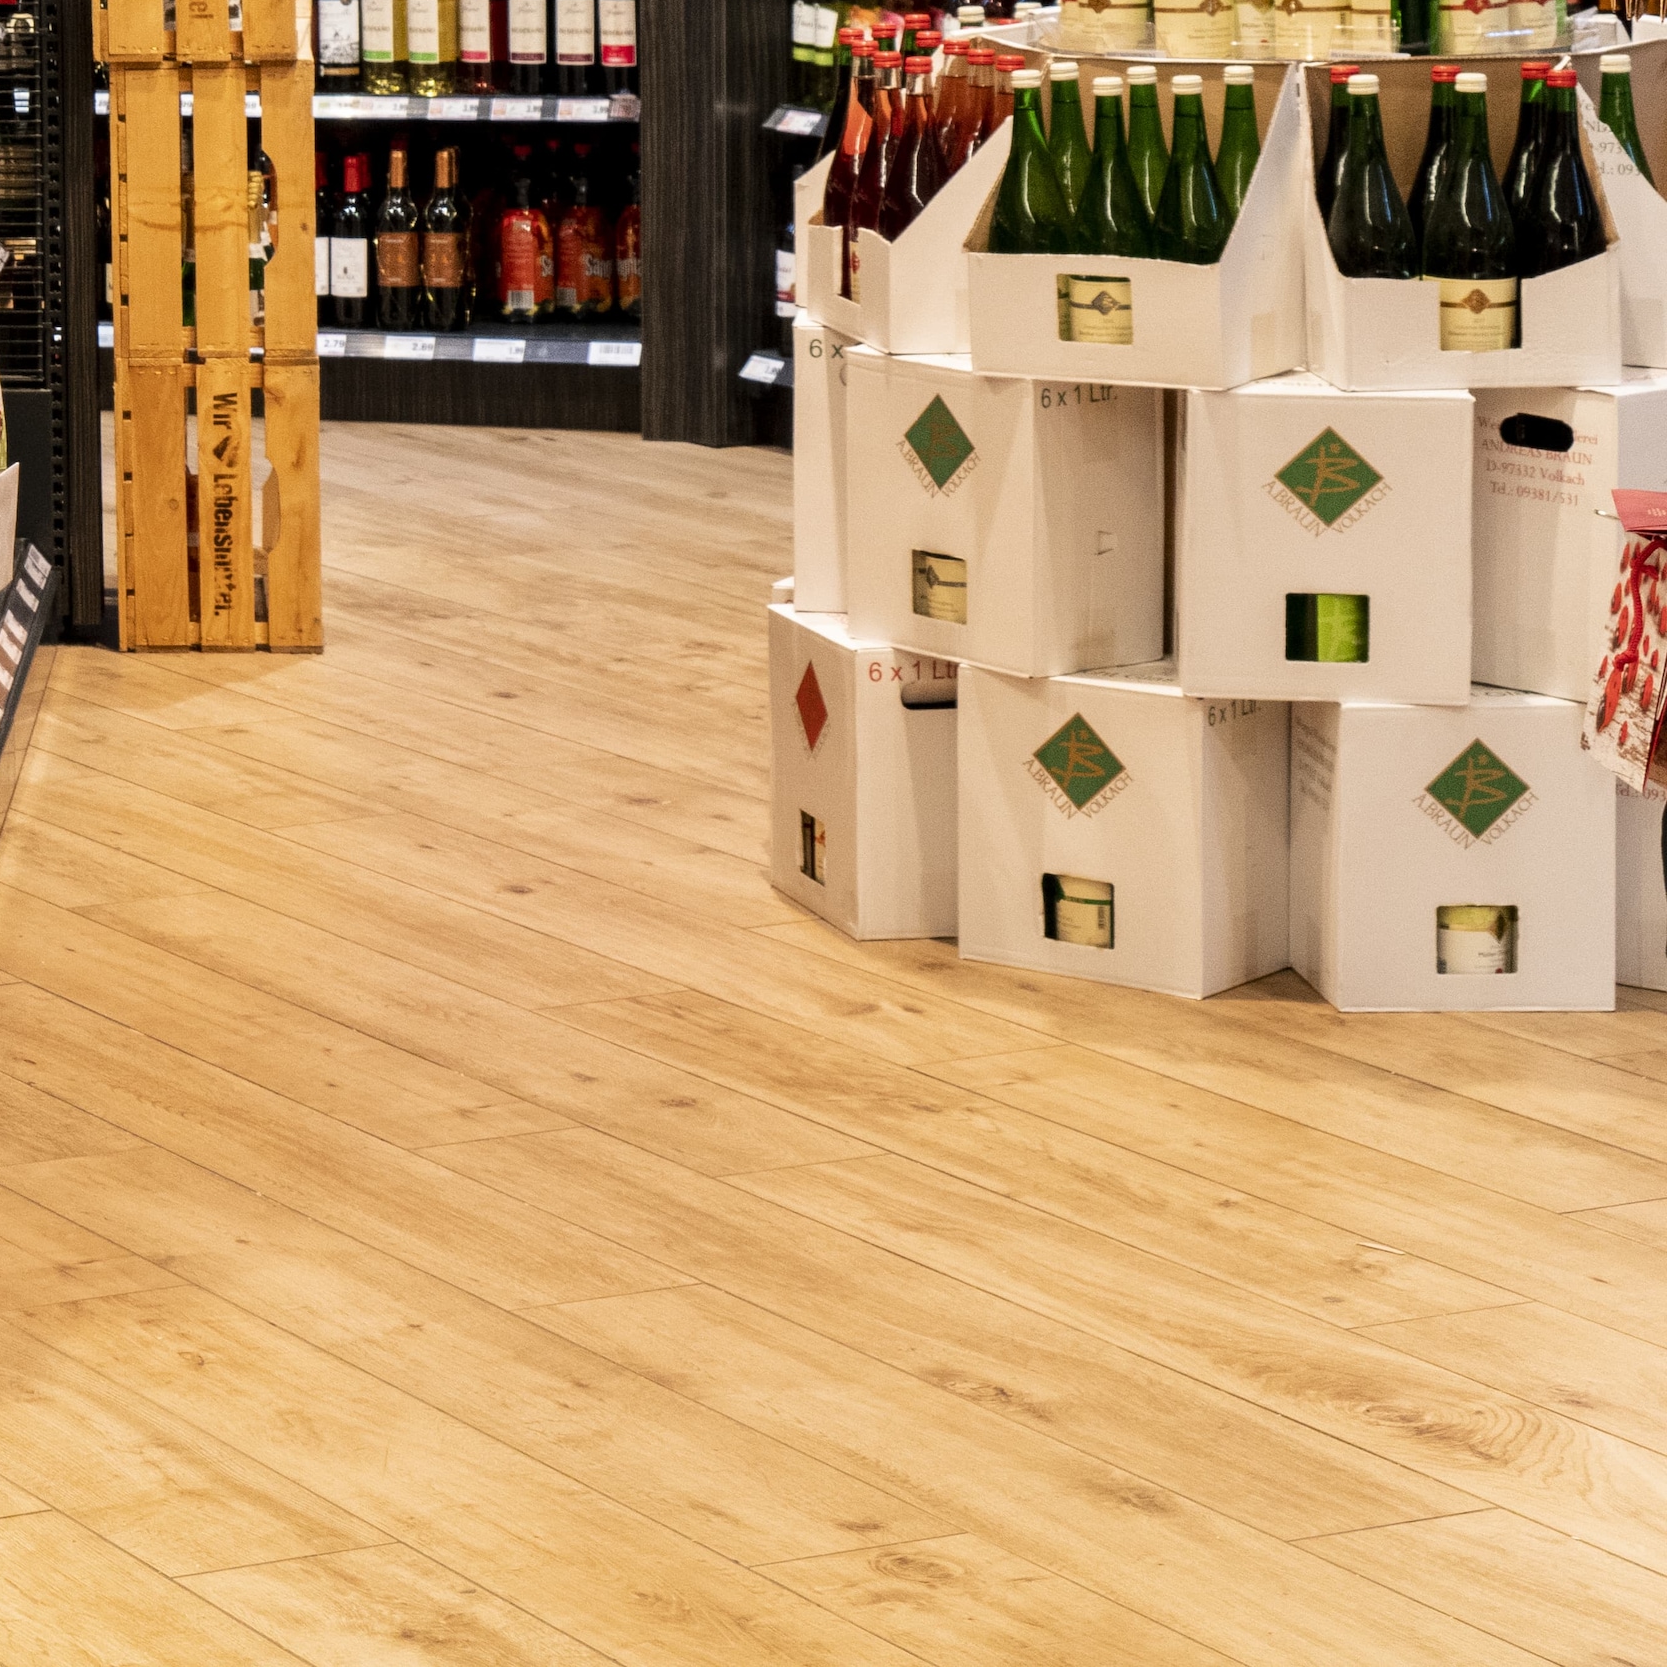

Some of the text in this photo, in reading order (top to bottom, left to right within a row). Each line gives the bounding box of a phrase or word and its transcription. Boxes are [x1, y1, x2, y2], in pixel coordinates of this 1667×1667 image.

[210, 391, 237, 430] Wir
[1041, 388, 1050, 408] 6
[1058, 391, 1067, 406] x
[1075, 387, 1081, 404] 1
[1545, 450, 1592, 465] BRAUN
[1486, 460, 1585, 486] D-97332 Volkach
[1331, 481, 1393, 535] VOLKACH
[1516, 485, 1578, 506] 09381/531
[869, 661, 919, 681] 6 x 1
[1081, 771, 1134, 819] VOLKACH
[1481, 791, 1539, 848] VOLKACH
